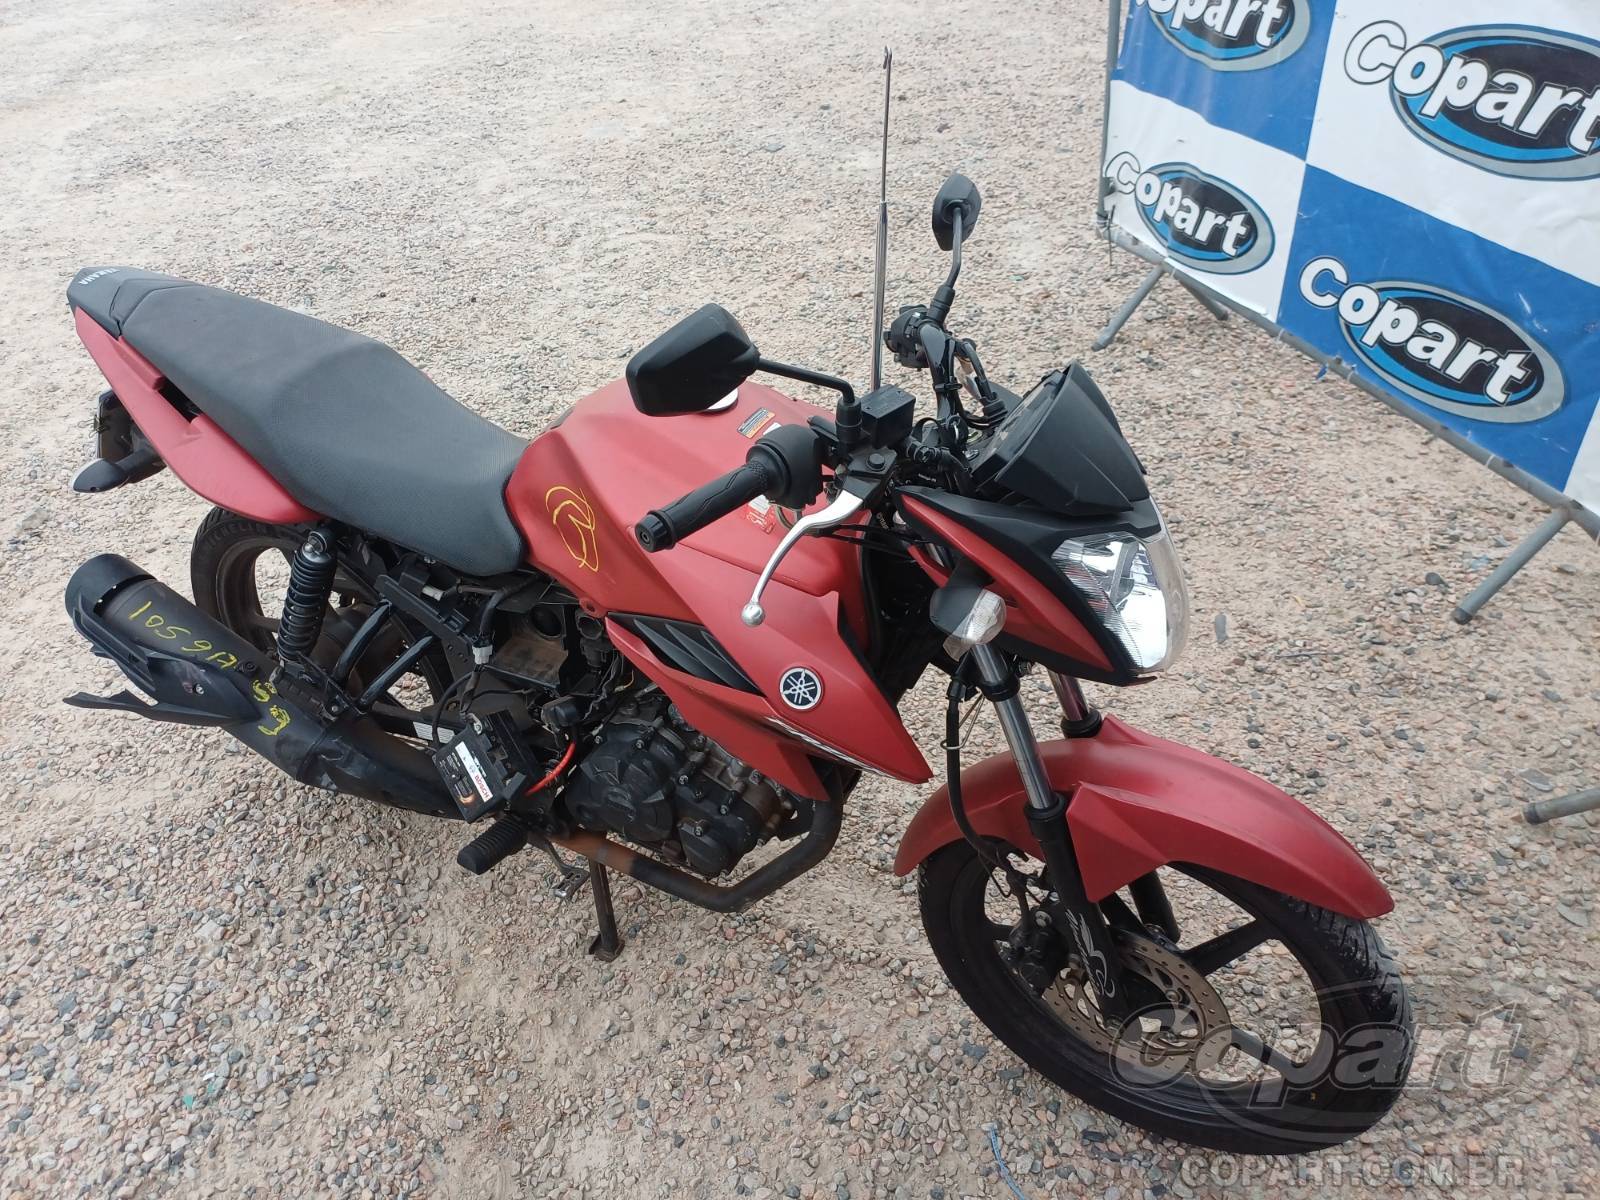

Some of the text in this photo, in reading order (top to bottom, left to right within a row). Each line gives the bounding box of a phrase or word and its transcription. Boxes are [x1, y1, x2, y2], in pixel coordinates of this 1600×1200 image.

[1104, 151, 1250, 258] Copart
[1299, 255, 1535, 406] Copart
[474, 774, 491, 799] BOSCH
